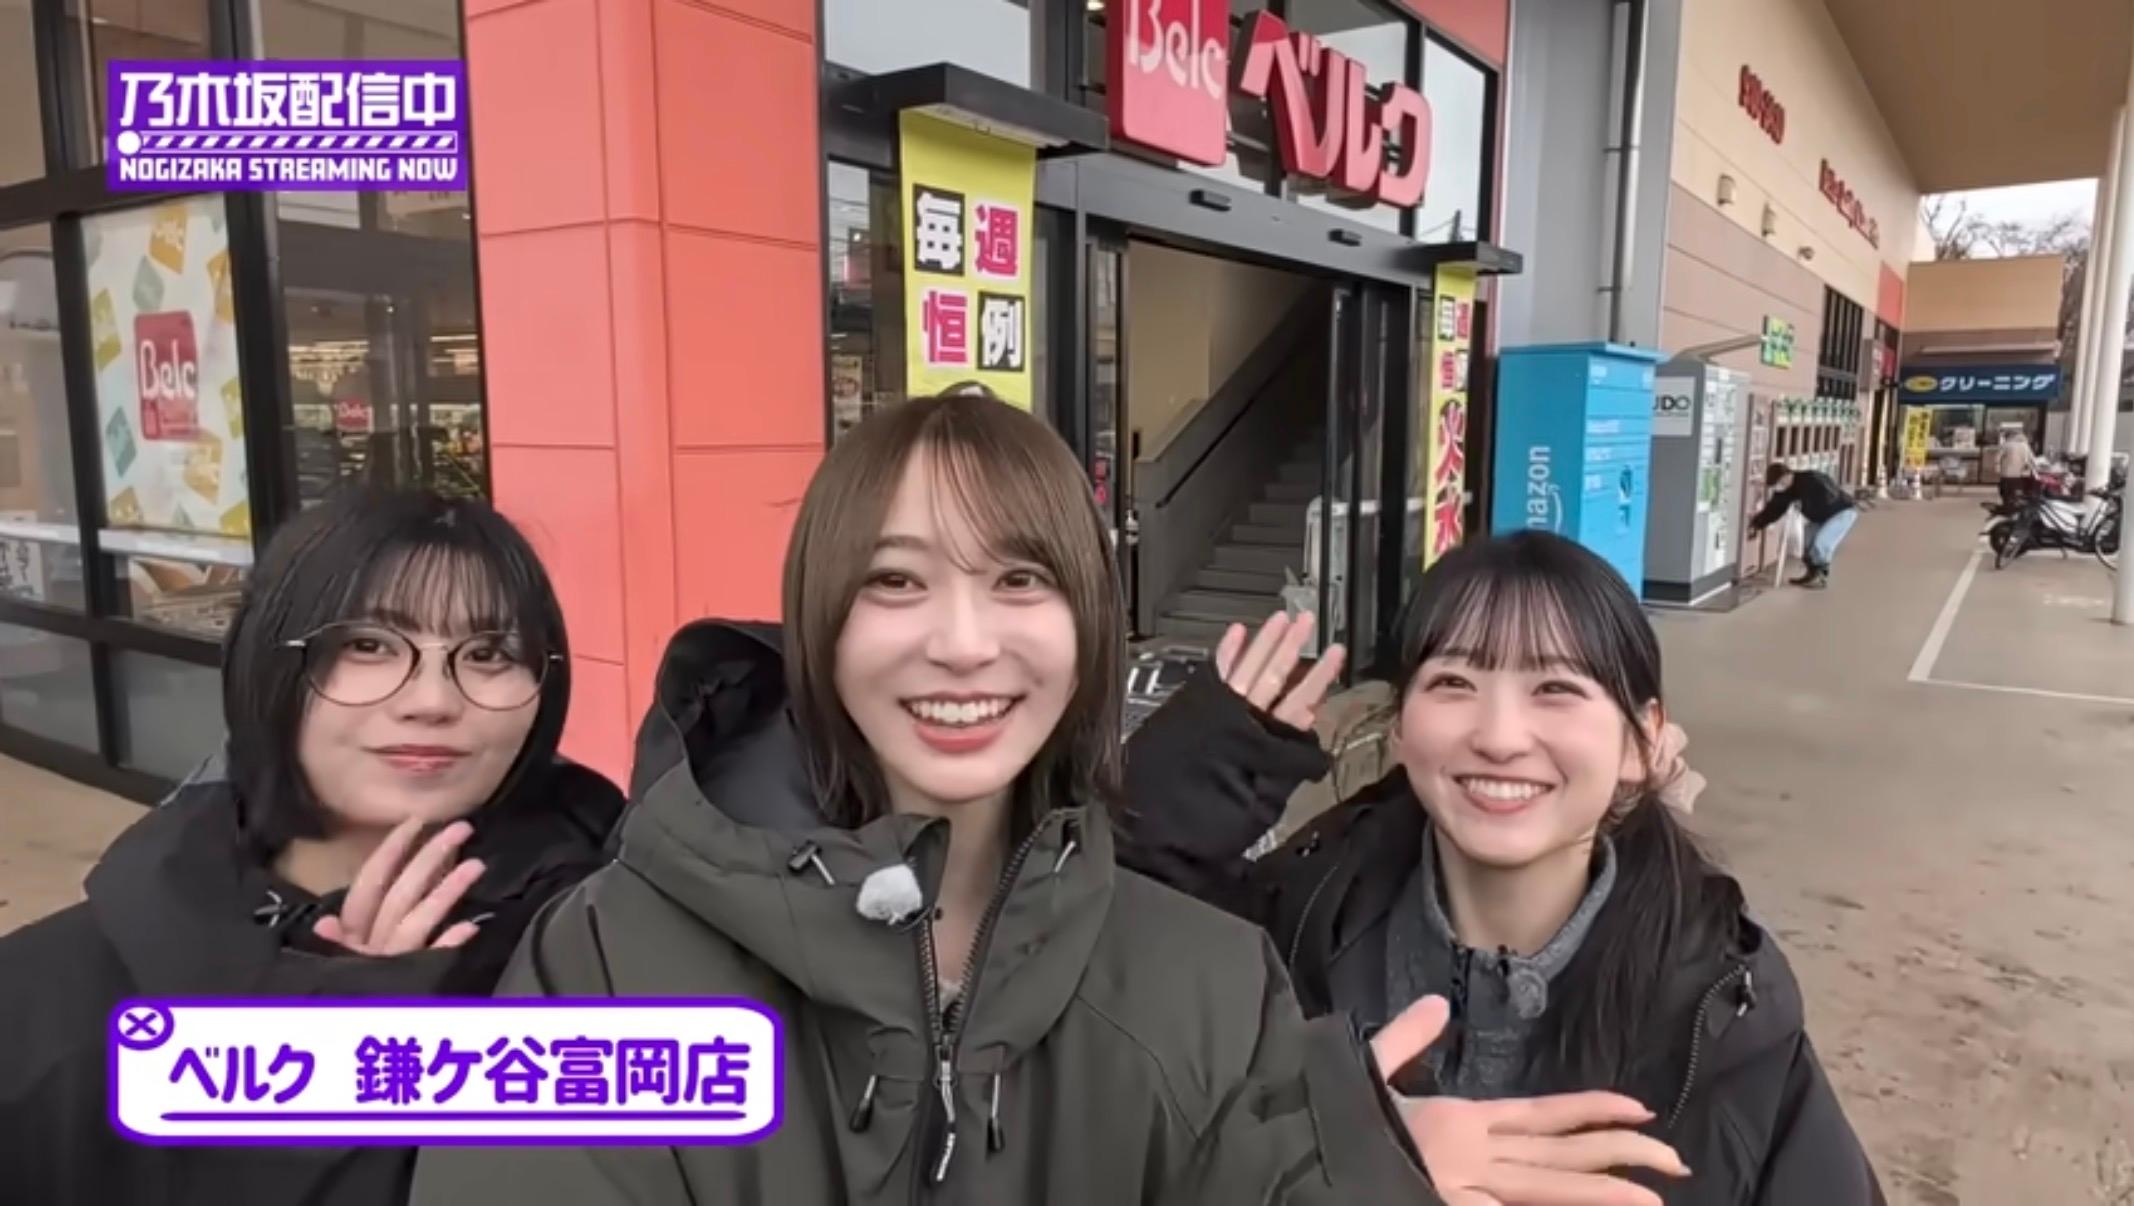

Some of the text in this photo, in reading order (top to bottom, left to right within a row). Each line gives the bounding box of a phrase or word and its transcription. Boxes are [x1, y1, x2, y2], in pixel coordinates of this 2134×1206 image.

[1126, 0, 1224, 99] Belc
[1240, 10, 1432, 207] ベルク
[916, 190, 1019, 278] 毎週
[139, 338, 197, 401] Belc
[922, 289, 1022, 369] 恒例
[1939, 373, 2056, 392] クリーニング
[1526, 446, 1551, 529] azon
